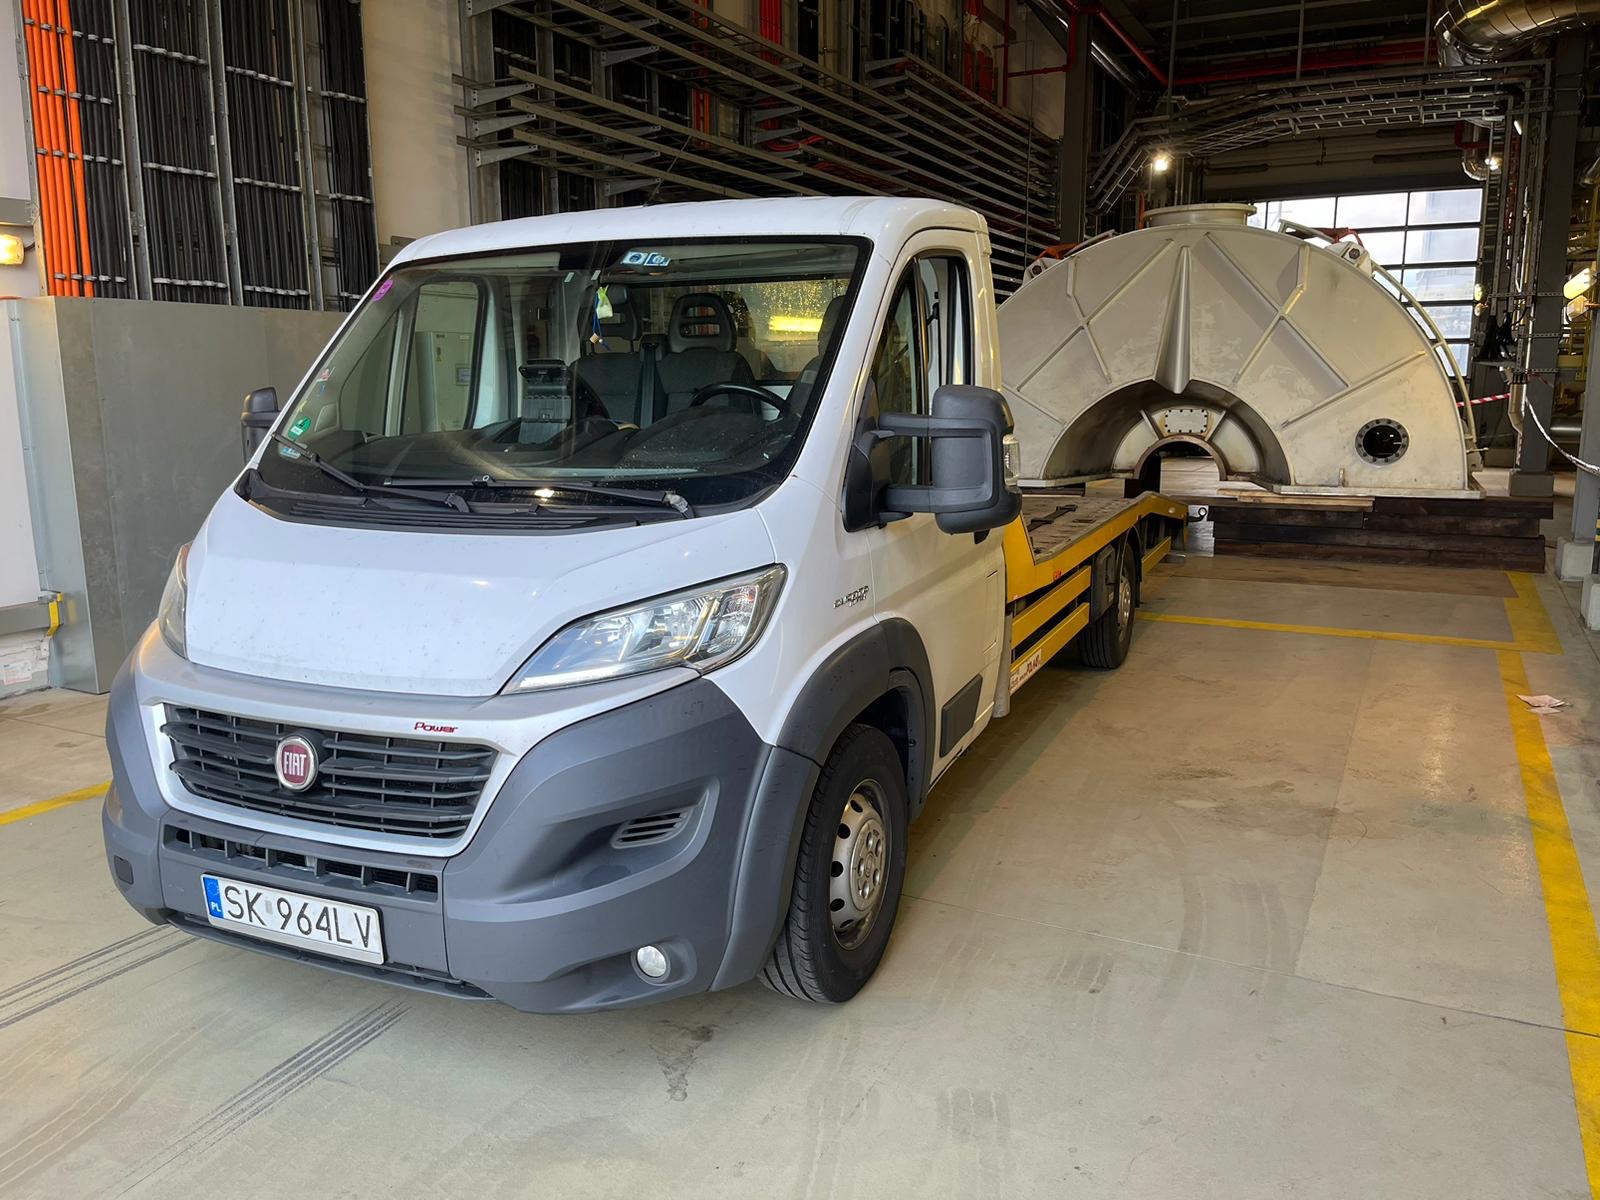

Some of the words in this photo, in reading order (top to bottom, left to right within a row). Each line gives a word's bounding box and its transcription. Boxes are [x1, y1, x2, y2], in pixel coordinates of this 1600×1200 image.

[414, 721, 458, 733] Power
[283, 751, 306, 776] FIAT
[210, 902, 221, 912] PL
[224, 885, 267, 926] SK
[276, 897, 371, 948] 964LV
